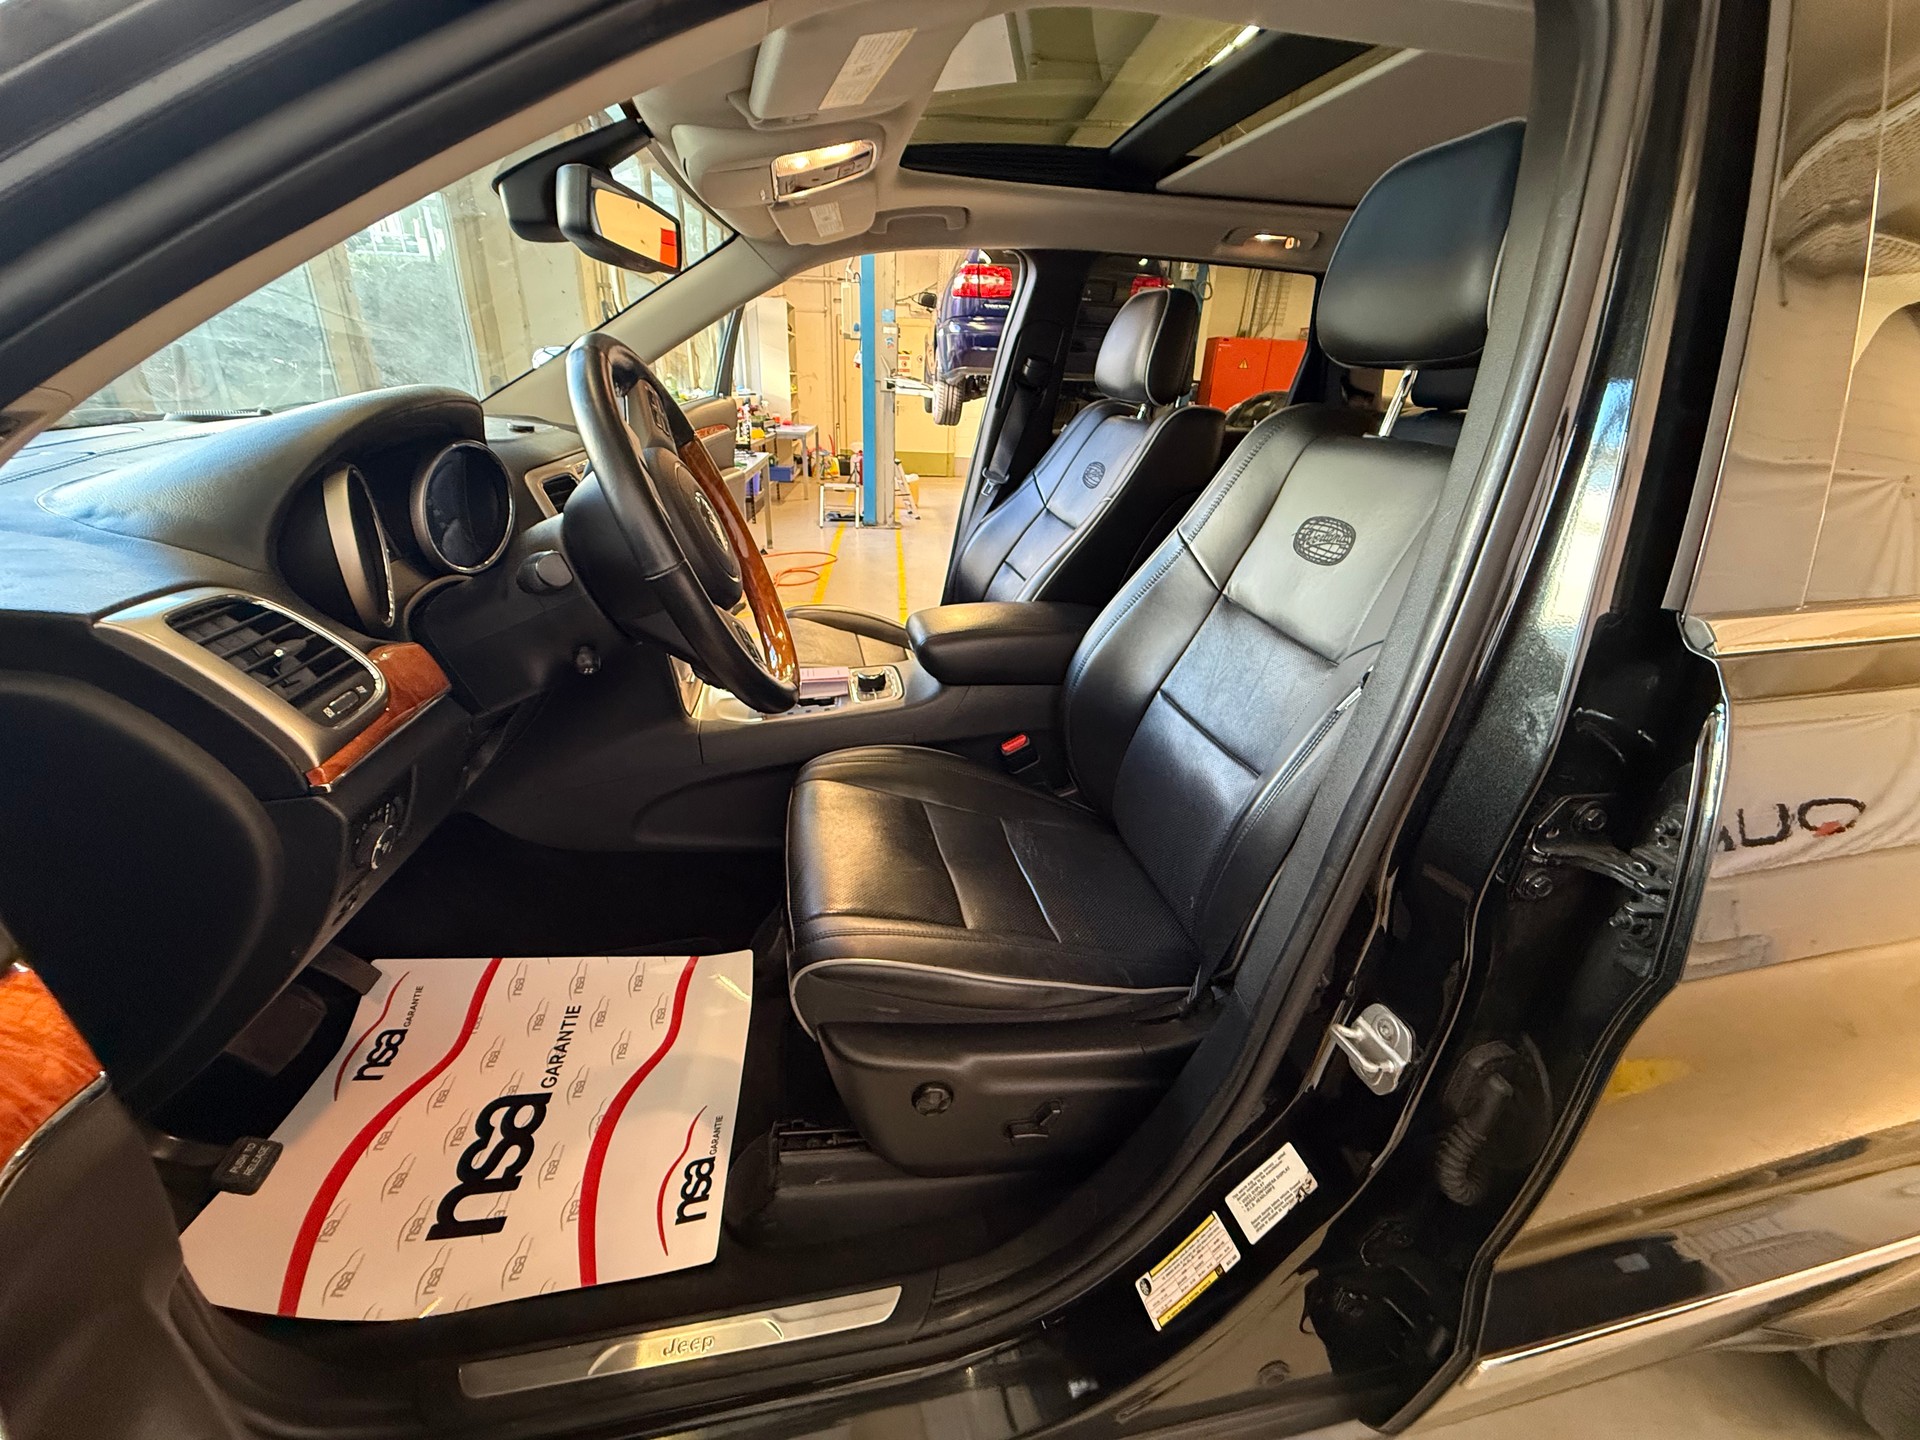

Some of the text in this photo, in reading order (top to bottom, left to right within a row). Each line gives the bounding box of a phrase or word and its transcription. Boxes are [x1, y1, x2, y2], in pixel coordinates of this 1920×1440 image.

[512, 977, 526, 996] nsa
[574, 975, 586, 994] nsa
[633, 974, 644, 992] nsa
[532, 1013, 546, 1031] nsa
[595, 1010, 607, 1028] nsa
[655, 1007, 667, 1024] nsa
[352, 985, 424, 1082] nsa GARANTIE
[485, 1050, 501, 1068] nsa
[616, 1043, 629, 1060] nsa
[432, 1089, 450, 1109] nsa
[572, 1080, 585, 1099] nsa
[425, 1004, 582, 1242] nsa GARANTIE
[373, 1130, 393, 1151] nsa
[450, 1125, 467, 1147] nsa
[229, 1142, 257, 1174] PUSH TO
[243, 1145, 271, 1176] RELEASE
[544, 1159, 560, 1181] nsa
[675, 1114, 724, 1226] nsa GARANTIE
[387, 1172, 409, 1195] nsa
[405, 1217, 425, 1242] nsa
[508, 1255, 527, 1282] nsa
[329, 1271, 356, 1298] nsa
[422, 1267, 444, 1295] nsa
[662, 1335, 716, 1357] Jeep
